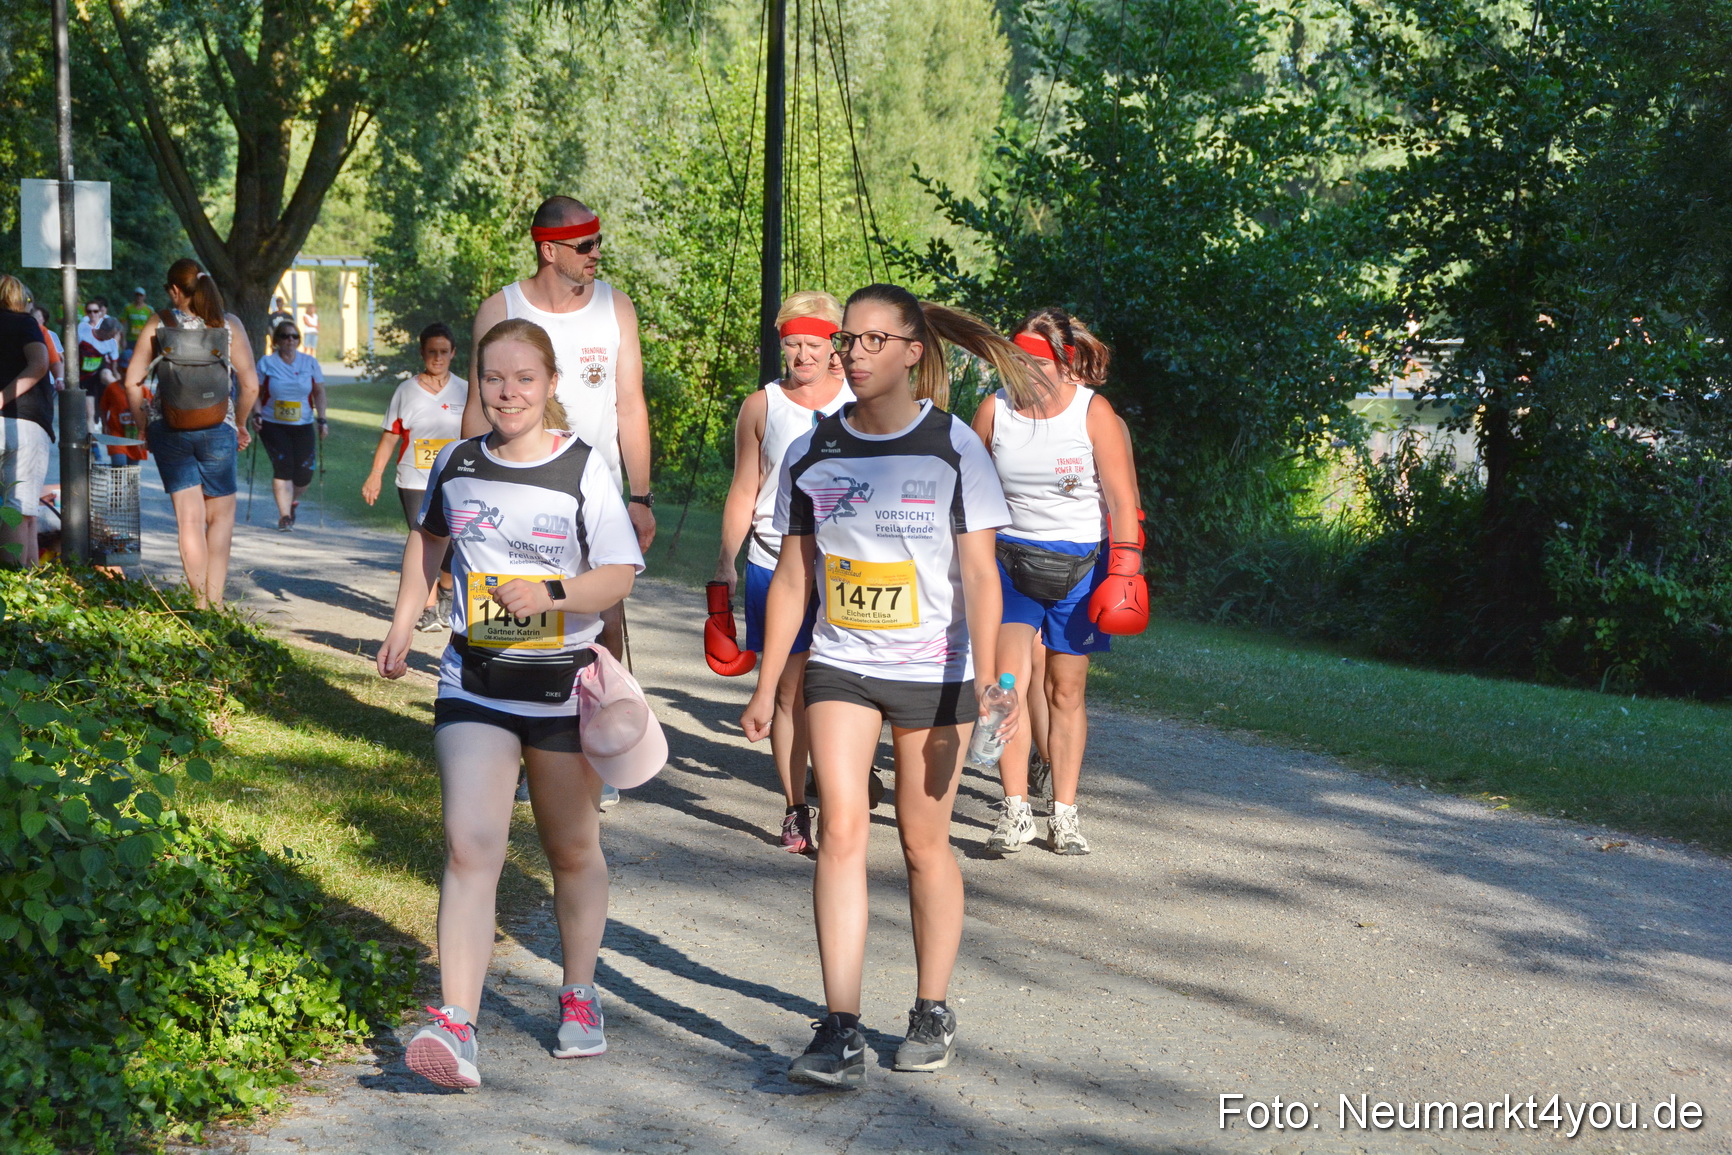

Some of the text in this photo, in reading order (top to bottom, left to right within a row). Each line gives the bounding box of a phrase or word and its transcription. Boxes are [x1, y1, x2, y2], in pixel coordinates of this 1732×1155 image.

[580, 355, 595, 363] POWER
[457, 465, 476, 473] erima
[1055, 466, 1072, 474] POWER
[875, 510, 935, 521] VORSICHT!
[875, 524, 933, 534] Freilaufende
[508, 540, 564, 554] VORSICHT!
[836, 583, 902, 610] 1477
[487, 627, 540, 636] Gärtner Katrin
